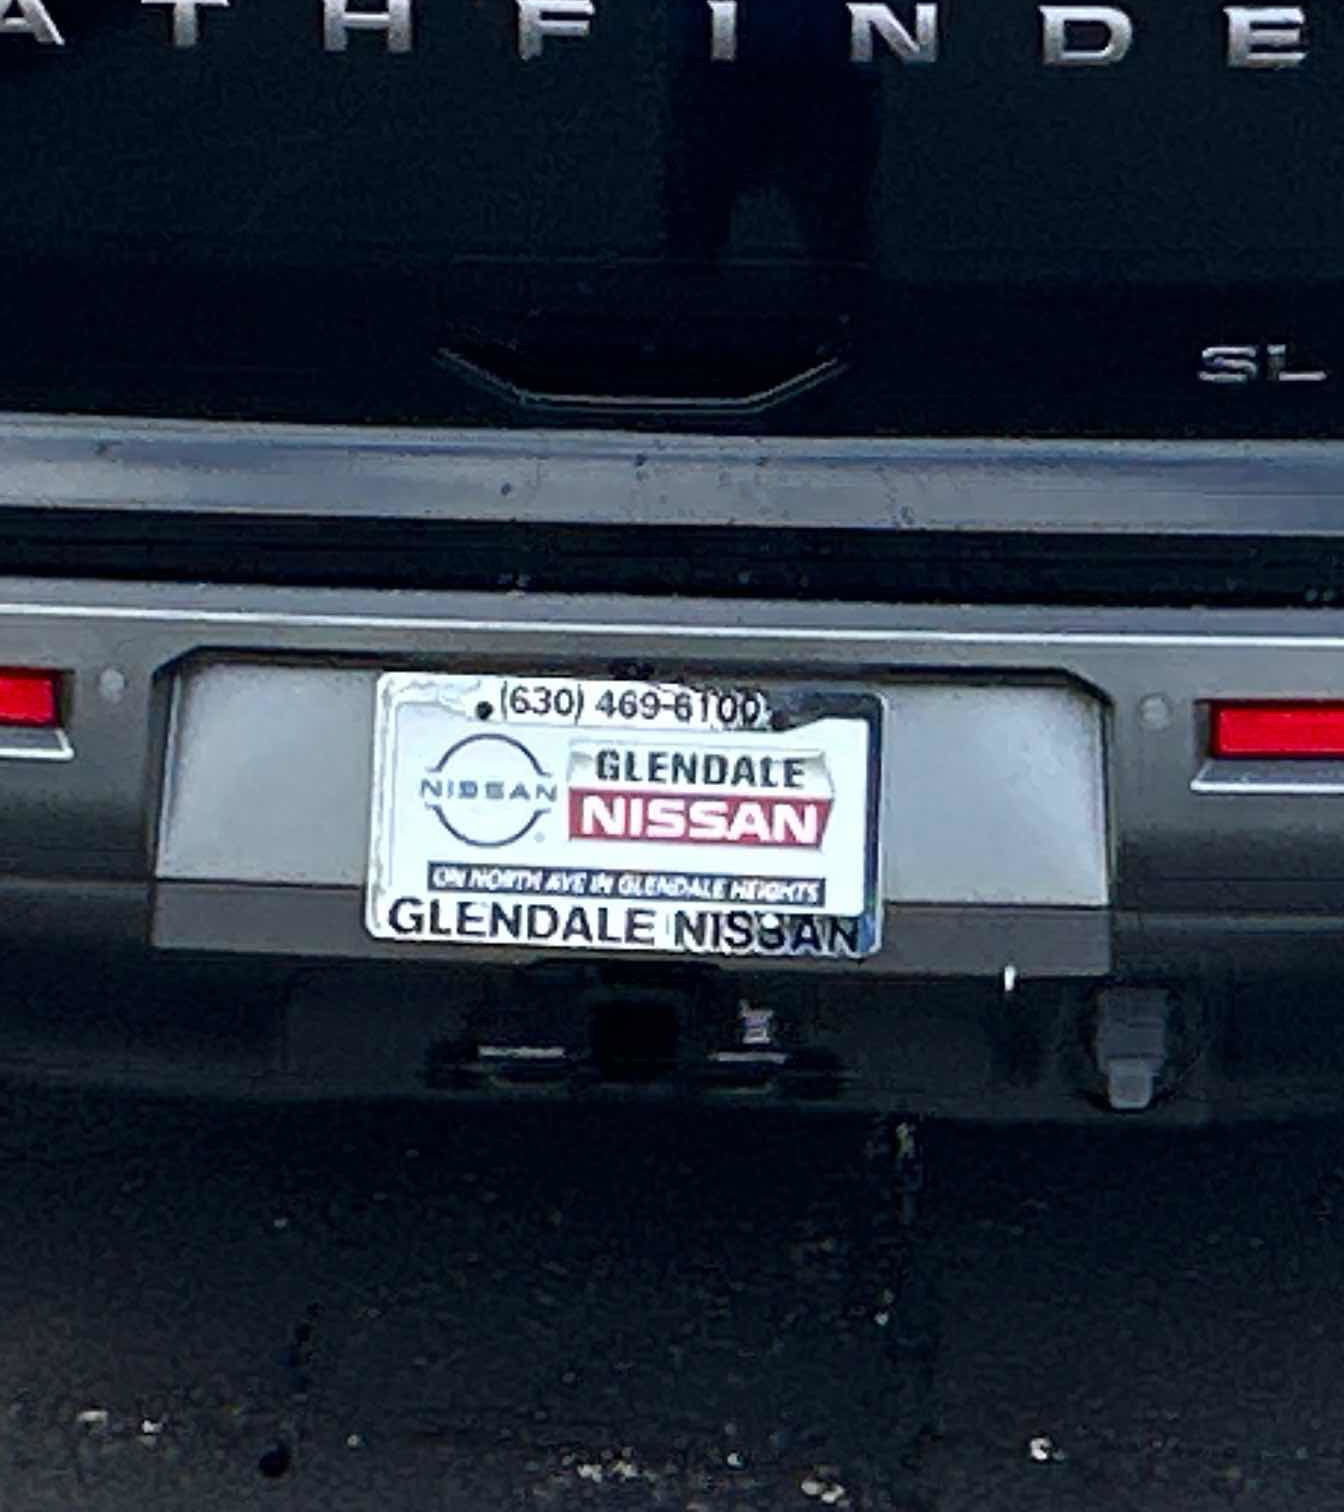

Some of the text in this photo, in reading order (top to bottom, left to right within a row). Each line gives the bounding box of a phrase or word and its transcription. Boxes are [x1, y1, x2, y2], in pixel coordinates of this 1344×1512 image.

[1197, 344, 1327, 383] SL
[500, 680, 764, 726] (630) 469-6100
[595, 748, 807, 789] GLENDALE
[419, 777, 558, 803] NISSAN
[579, 794, 818, 844] NISSAN
[432, 866, 819, 903] ON NORTH AVE IN GLENDALE HEIGHTS
[387, 896, 859, 952] GLENDALE NISSAN
